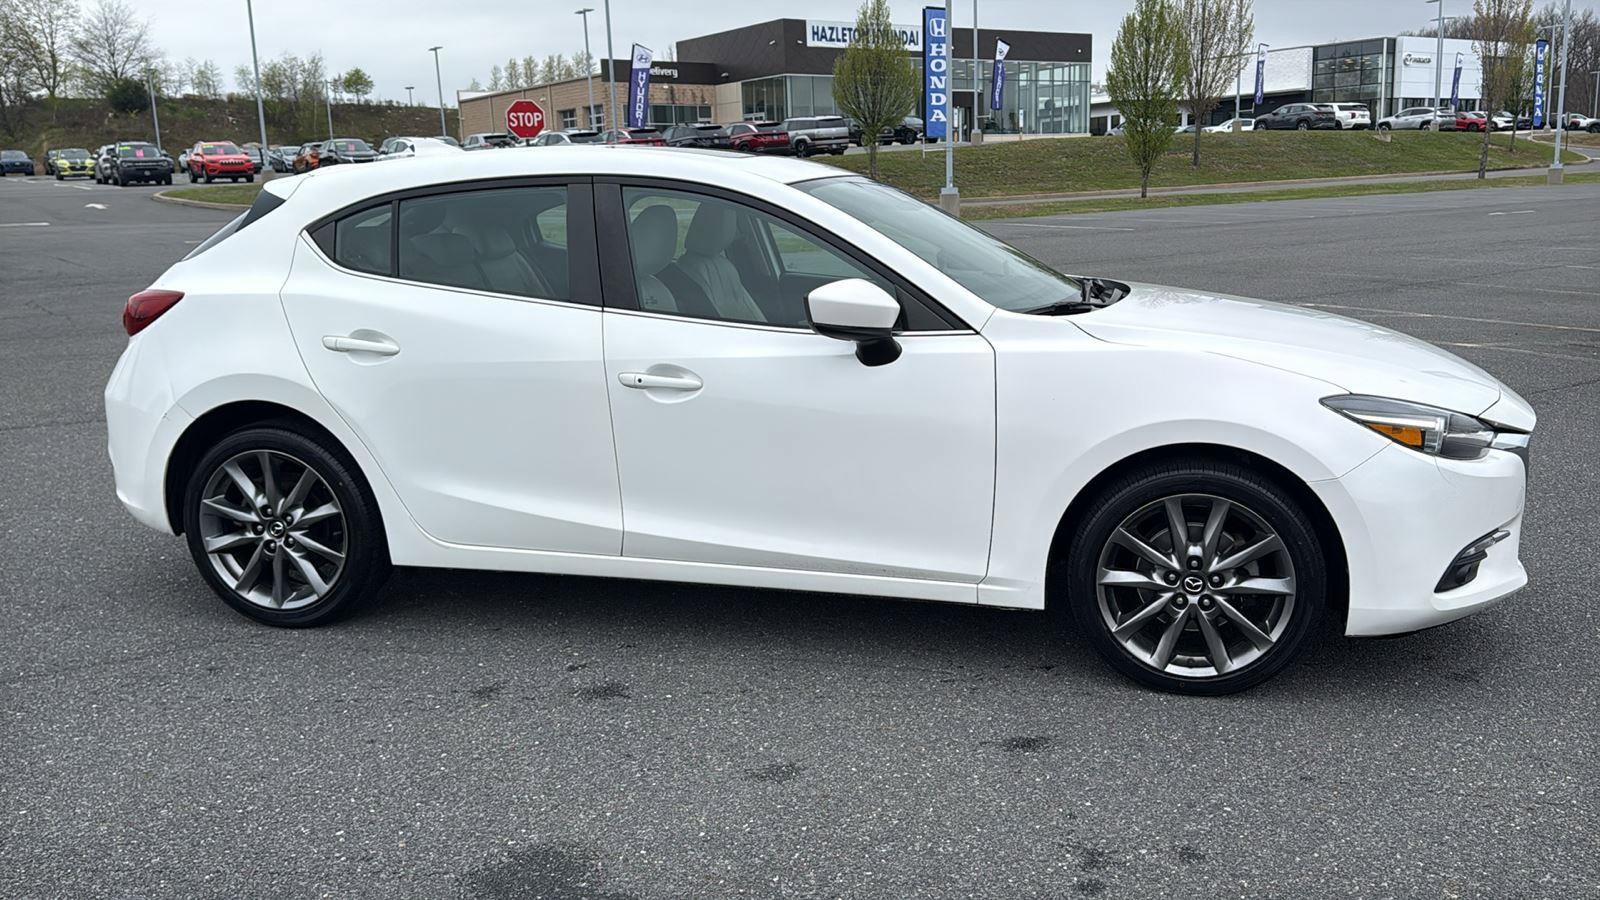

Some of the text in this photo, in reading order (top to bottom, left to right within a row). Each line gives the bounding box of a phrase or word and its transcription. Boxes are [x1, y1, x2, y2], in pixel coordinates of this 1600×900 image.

[635, 71, 646, 127] HYUNDAI
[650, 66, 678, 79] elivery
[929, 43, 947, 122] HONDA
[1535, 64, 1544, 117] HONDA
[509, 112, 542, 127] STOP
